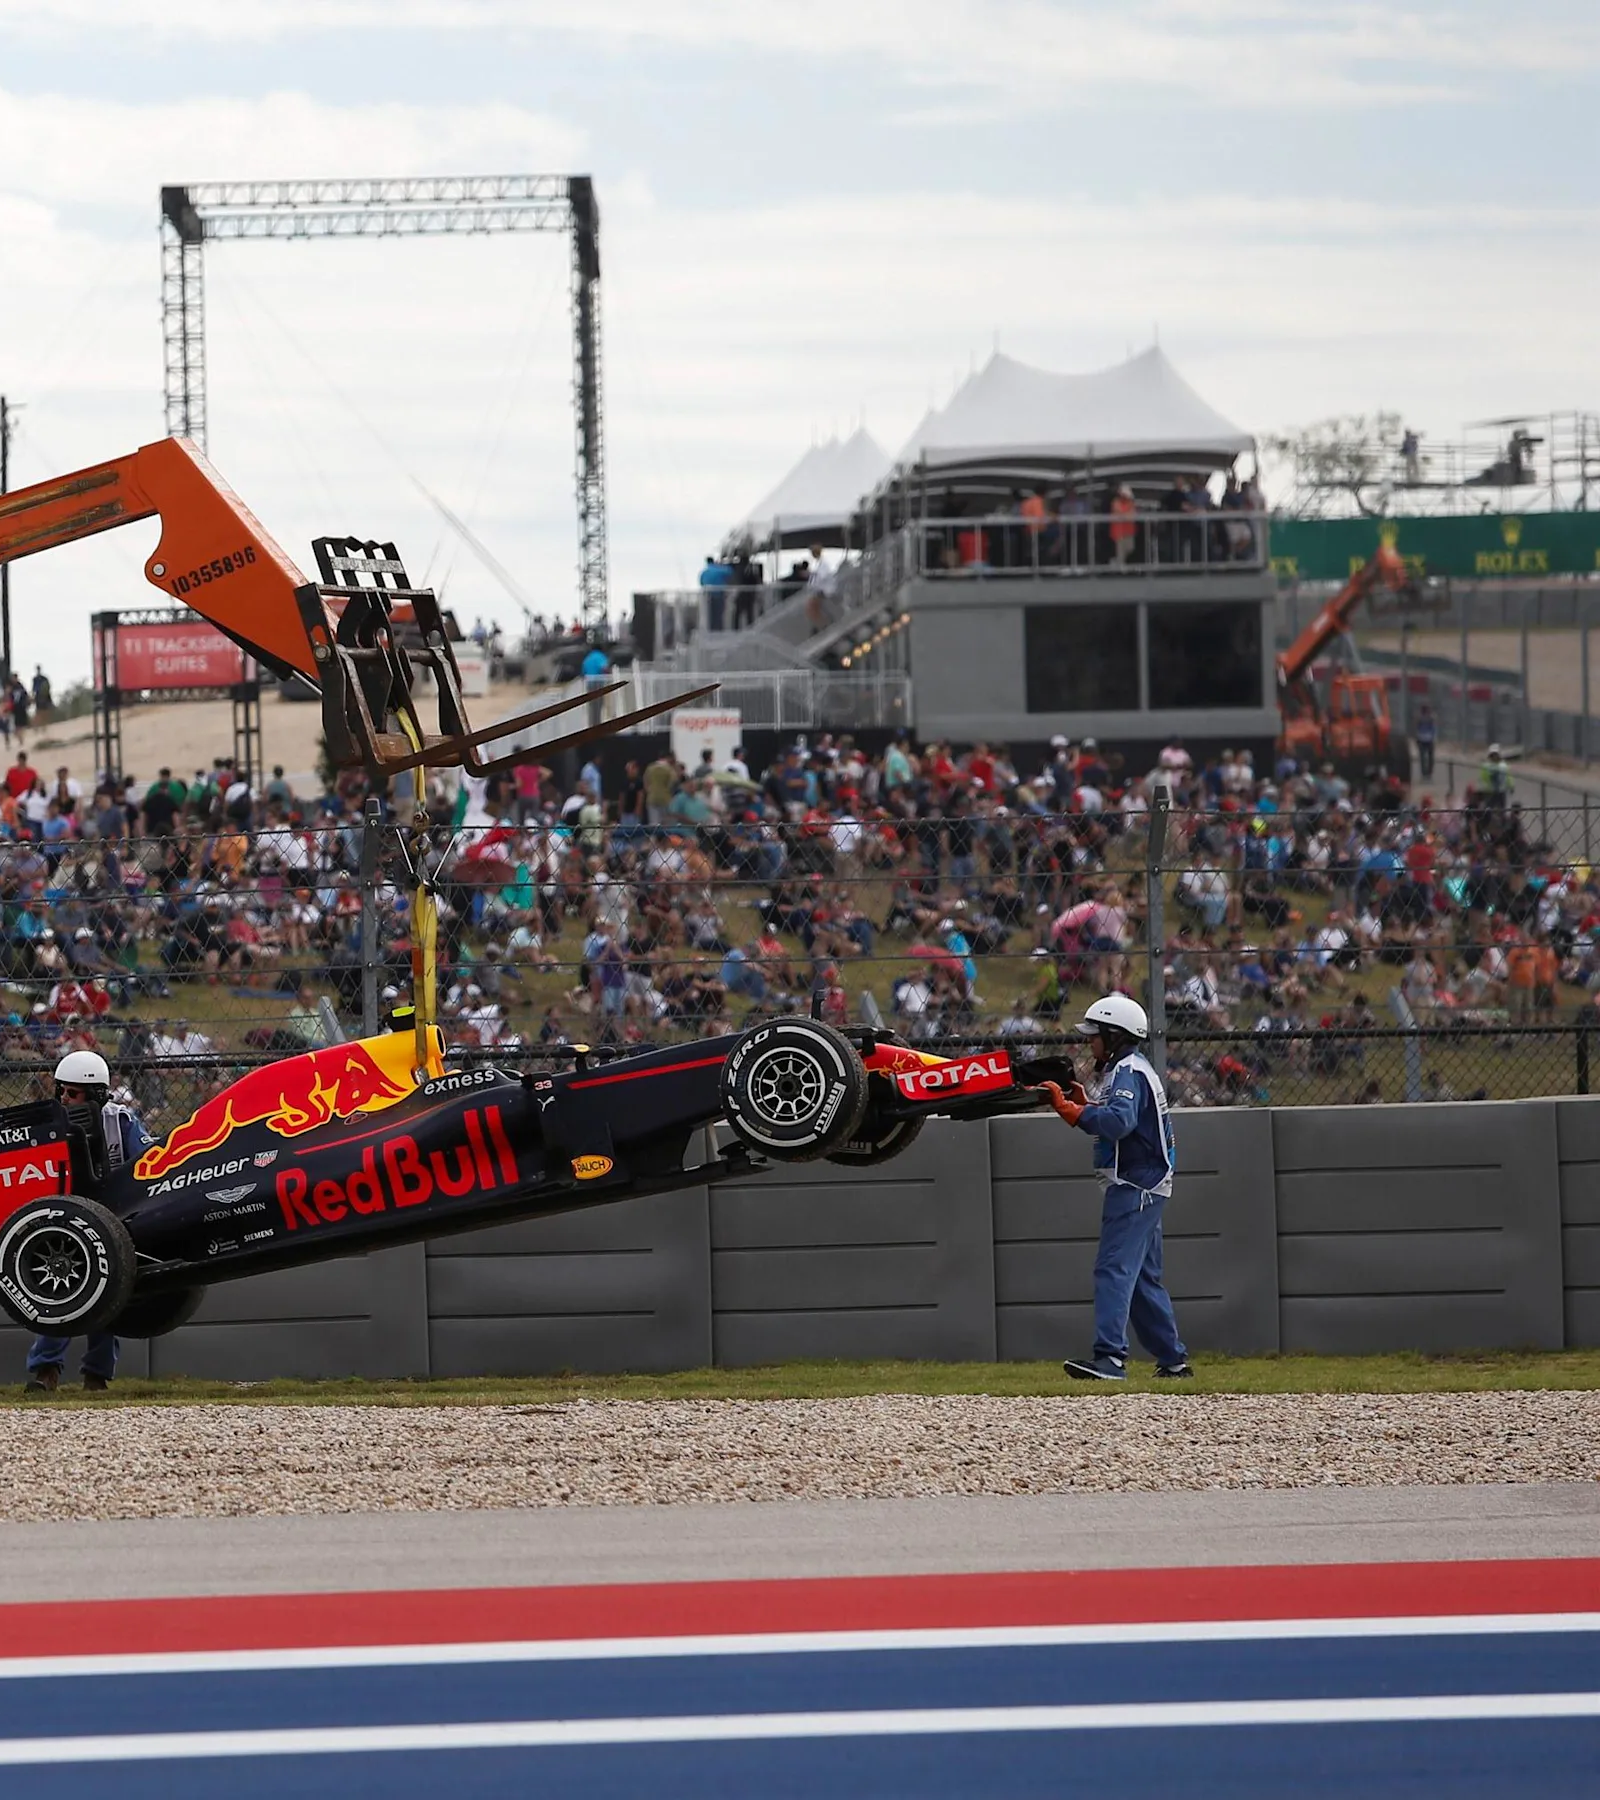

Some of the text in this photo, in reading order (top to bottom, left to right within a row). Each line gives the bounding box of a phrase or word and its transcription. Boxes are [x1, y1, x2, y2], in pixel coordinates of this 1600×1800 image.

[172, 546, 256, 596] 10355896
[1476, 550, 1547, 574] ROLEX
[125, 638, 142, 654] T1
[155, 655, 207, 673] SUITES
[727, 1028, 770, 1088] ZERO
[424, 1069, 495, 1095] exness
[534, 1080, 553, 1090] 33
[896, 1058, 1010, 1092] TOTAL
[814, 1081, 847, 1134] PIRELLI
[203, 1202, 266, 1222] ASTON MARTIN
[47, 1210, 109, 1275] P ZERO
[244, 1228, 274, 1242] SIEMENS
[0, 1275, 39, 1321] PIRELLI
